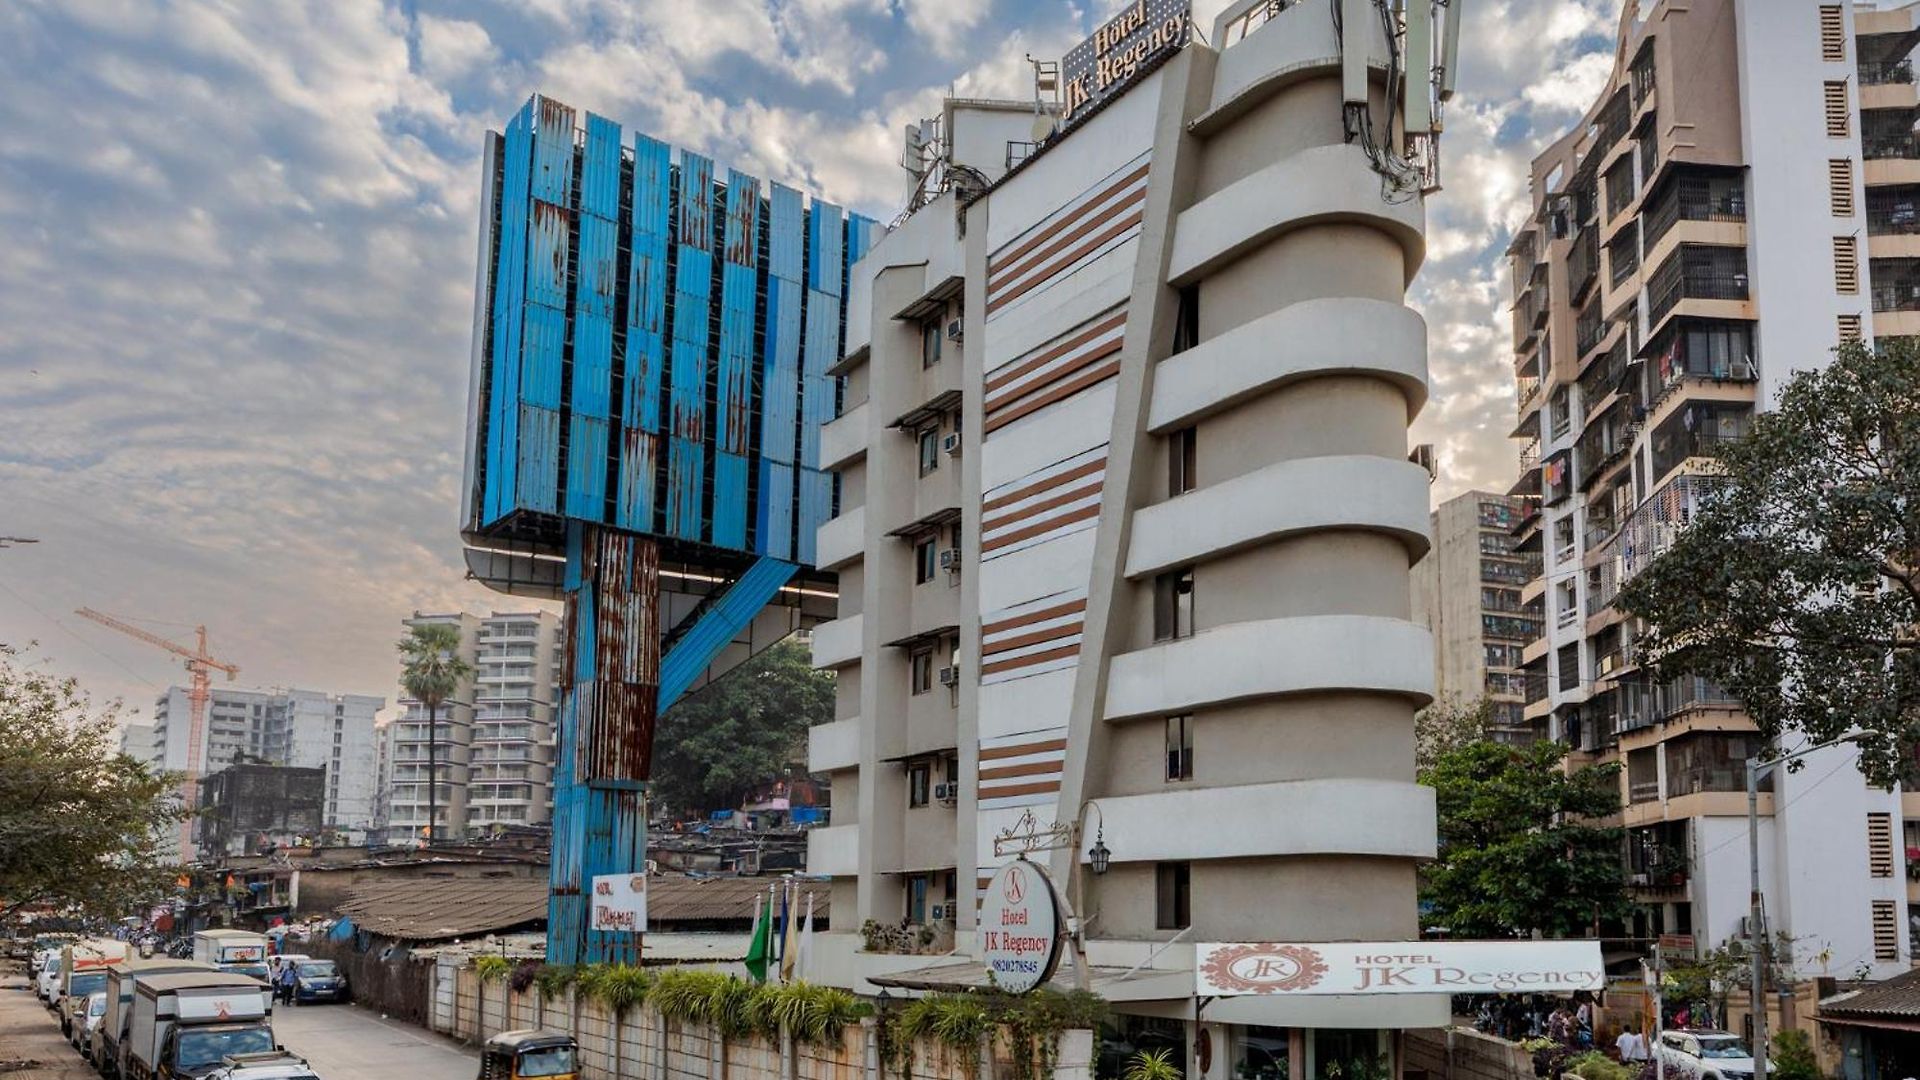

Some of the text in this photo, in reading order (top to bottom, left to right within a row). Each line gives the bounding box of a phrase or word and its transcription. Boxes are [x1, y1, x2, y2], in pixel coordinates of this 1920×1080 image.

[1094, 0, 1148, 57] Hotel
[1062, 8, 1190, 120] JK Regency
[1001, 908, 1028, 926] Hotel
[984, 931, 1049, 956] JK Regency
[1354, 955, 1441, 964] HOTEL
[1353, 966, 1600, 991] JK Regency
